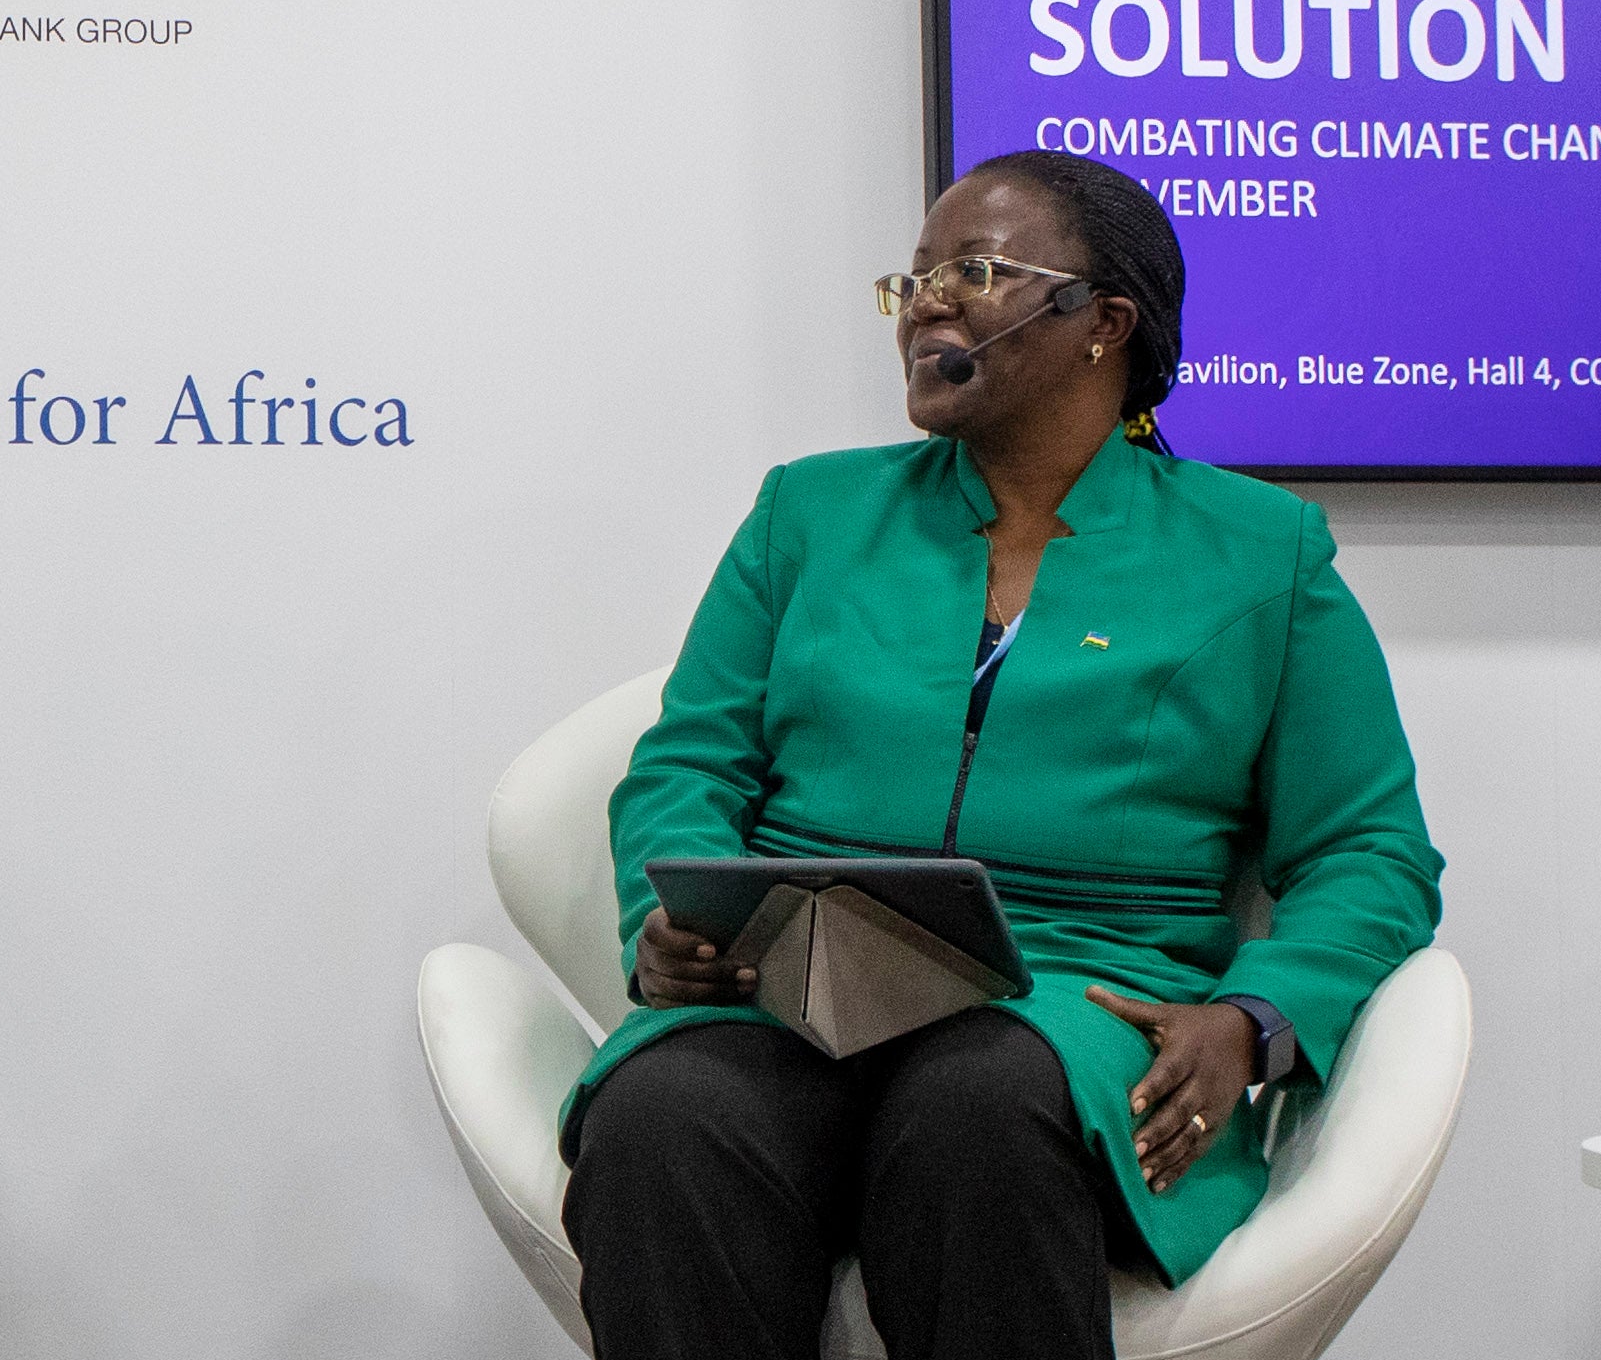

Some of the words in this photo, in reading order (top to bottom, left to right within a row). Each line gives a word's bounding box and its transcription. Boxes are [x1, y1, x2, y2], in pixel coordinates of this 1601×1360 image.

[76, 18, 193, 45] GROUP
[1036, 116, 1298, 158] COMBATING
[1310, 119, 1490, 162] CLIMATE
[1298, 355, 1364, 386] Blue
[1373, 356, 1458, 391] Zone,
[1468, 356, 1525, 387] Hall
[1533, 357, 1561, 391] 4,
[8, 367, 127, 446] for
[154, 369, 415, 448] Africa
